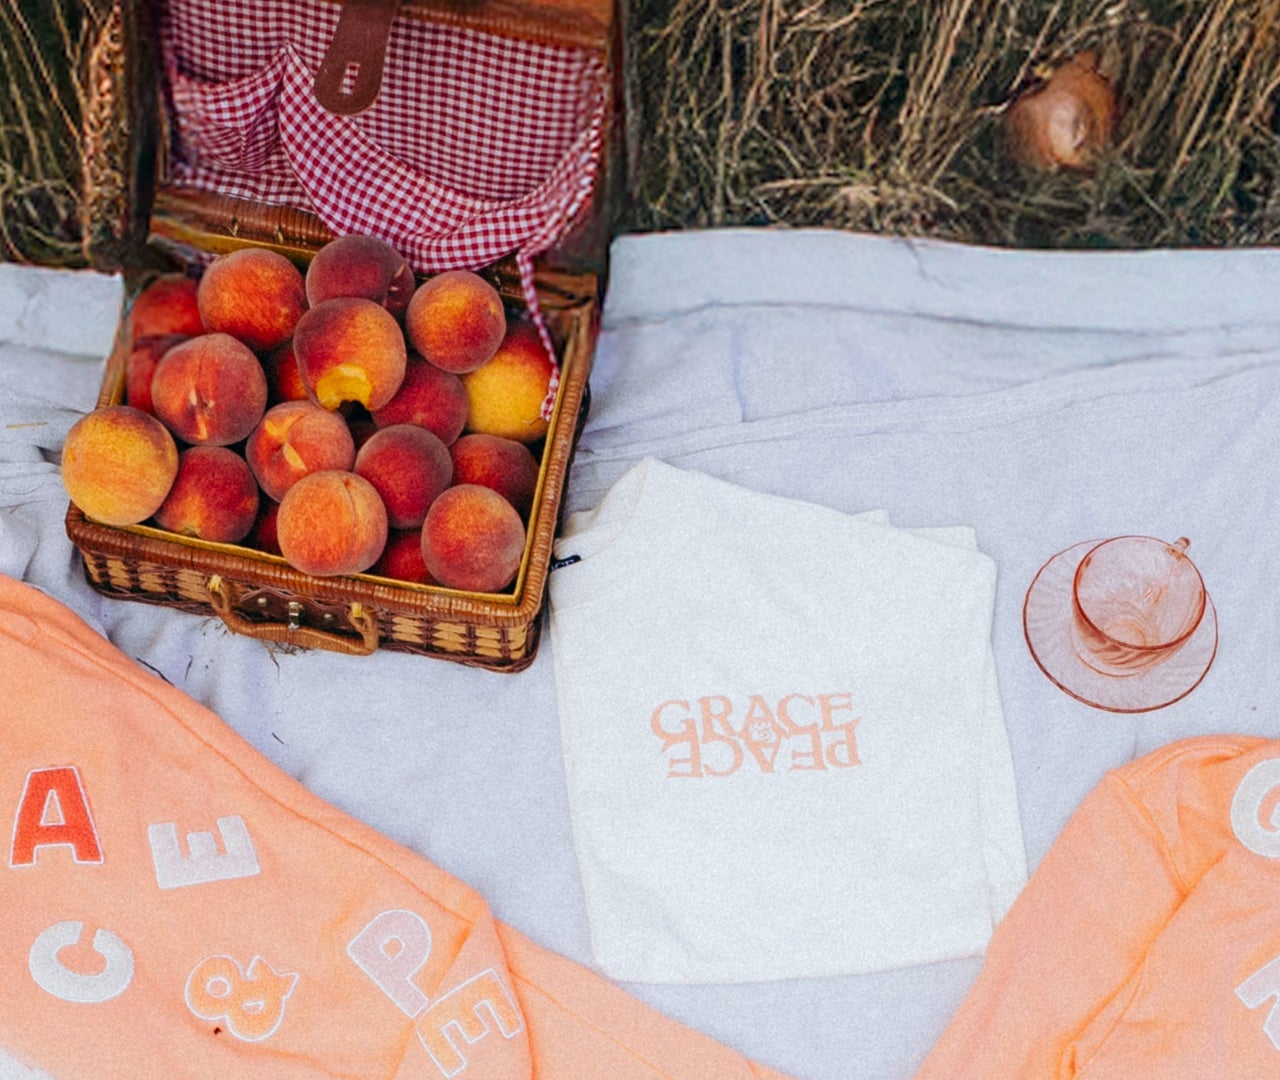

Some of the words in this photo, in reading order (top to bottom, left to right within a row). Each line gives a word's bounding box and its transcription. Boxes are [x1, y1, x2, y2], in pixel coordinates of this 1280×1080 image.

[650, 692, 855, 744] GRACE
[660, 716, 863, 779] PEACE
[9, 765, 104, 867] A
[147, 815, 261, 890] E
[28, 920, 136, 1003] C
[184, 954, 300, 1041] &
[346, 909, 432, 1018] P
[416, 969, 525, 1078] E
